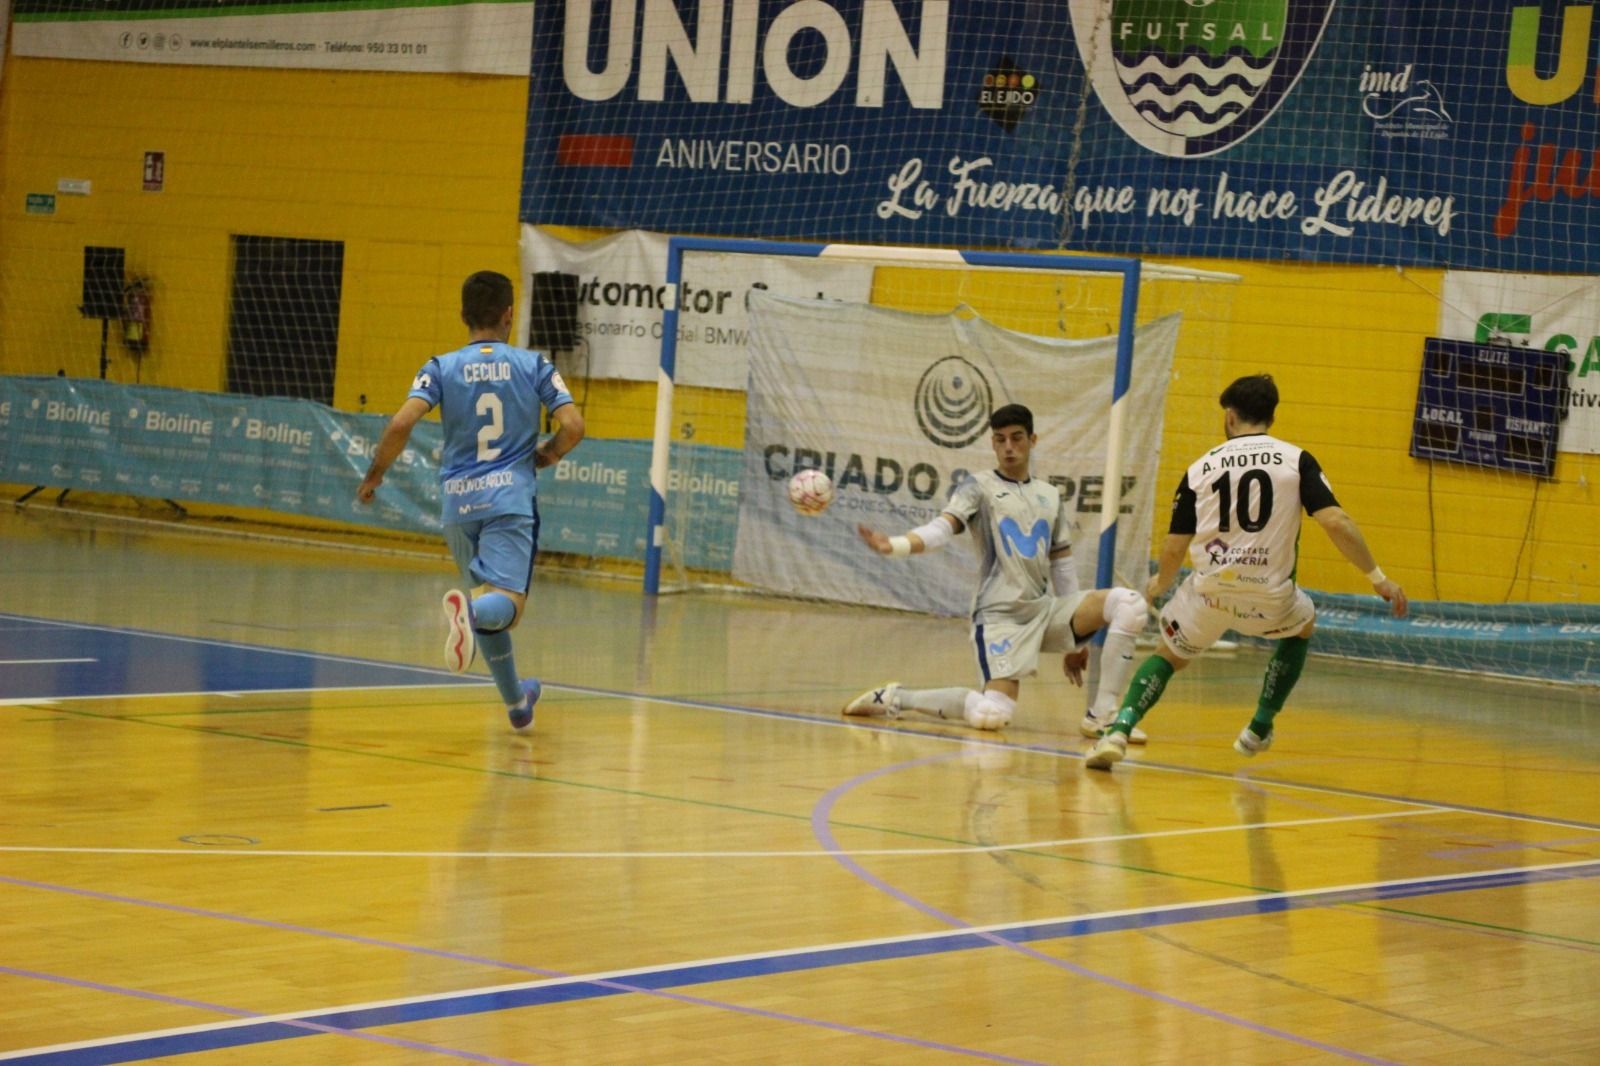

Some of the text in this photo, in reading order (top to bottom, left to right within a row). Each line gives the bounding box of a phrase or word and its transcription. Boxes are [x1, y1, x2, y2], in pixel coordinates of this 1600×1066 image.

[1120, 22, 1273, 41] FUTSAL
[1359, 64, 1412, 92] imd
[656, 138, 852, 176] ANIVERSARIO
[877, 158, 939, 219] La
[946, 155, 1064, 217] Fuerza
[1073, 185, 1137, 230] que
[1146, 187, 1202, 227] nos
[1212, 171, 1298, 223] hace
[704, 325, 750, 346] BMW
[464, 362, 511, 383] CECILIO
[46, 401, 111, 426] Bioline
[146, 410, 214, 436] Bioline
[1421, 407, 1464, 425] LOCAL
[245, 419, 313, 447] Bioline
[476, 392, 504, 462] 2
[554, 460, 628, 486] Bioline
[1202, 451, 1284, 475] A. MOTOS
[667, 469, 740, 497] Bioline
[1211, 468, 1274, 533] 10
